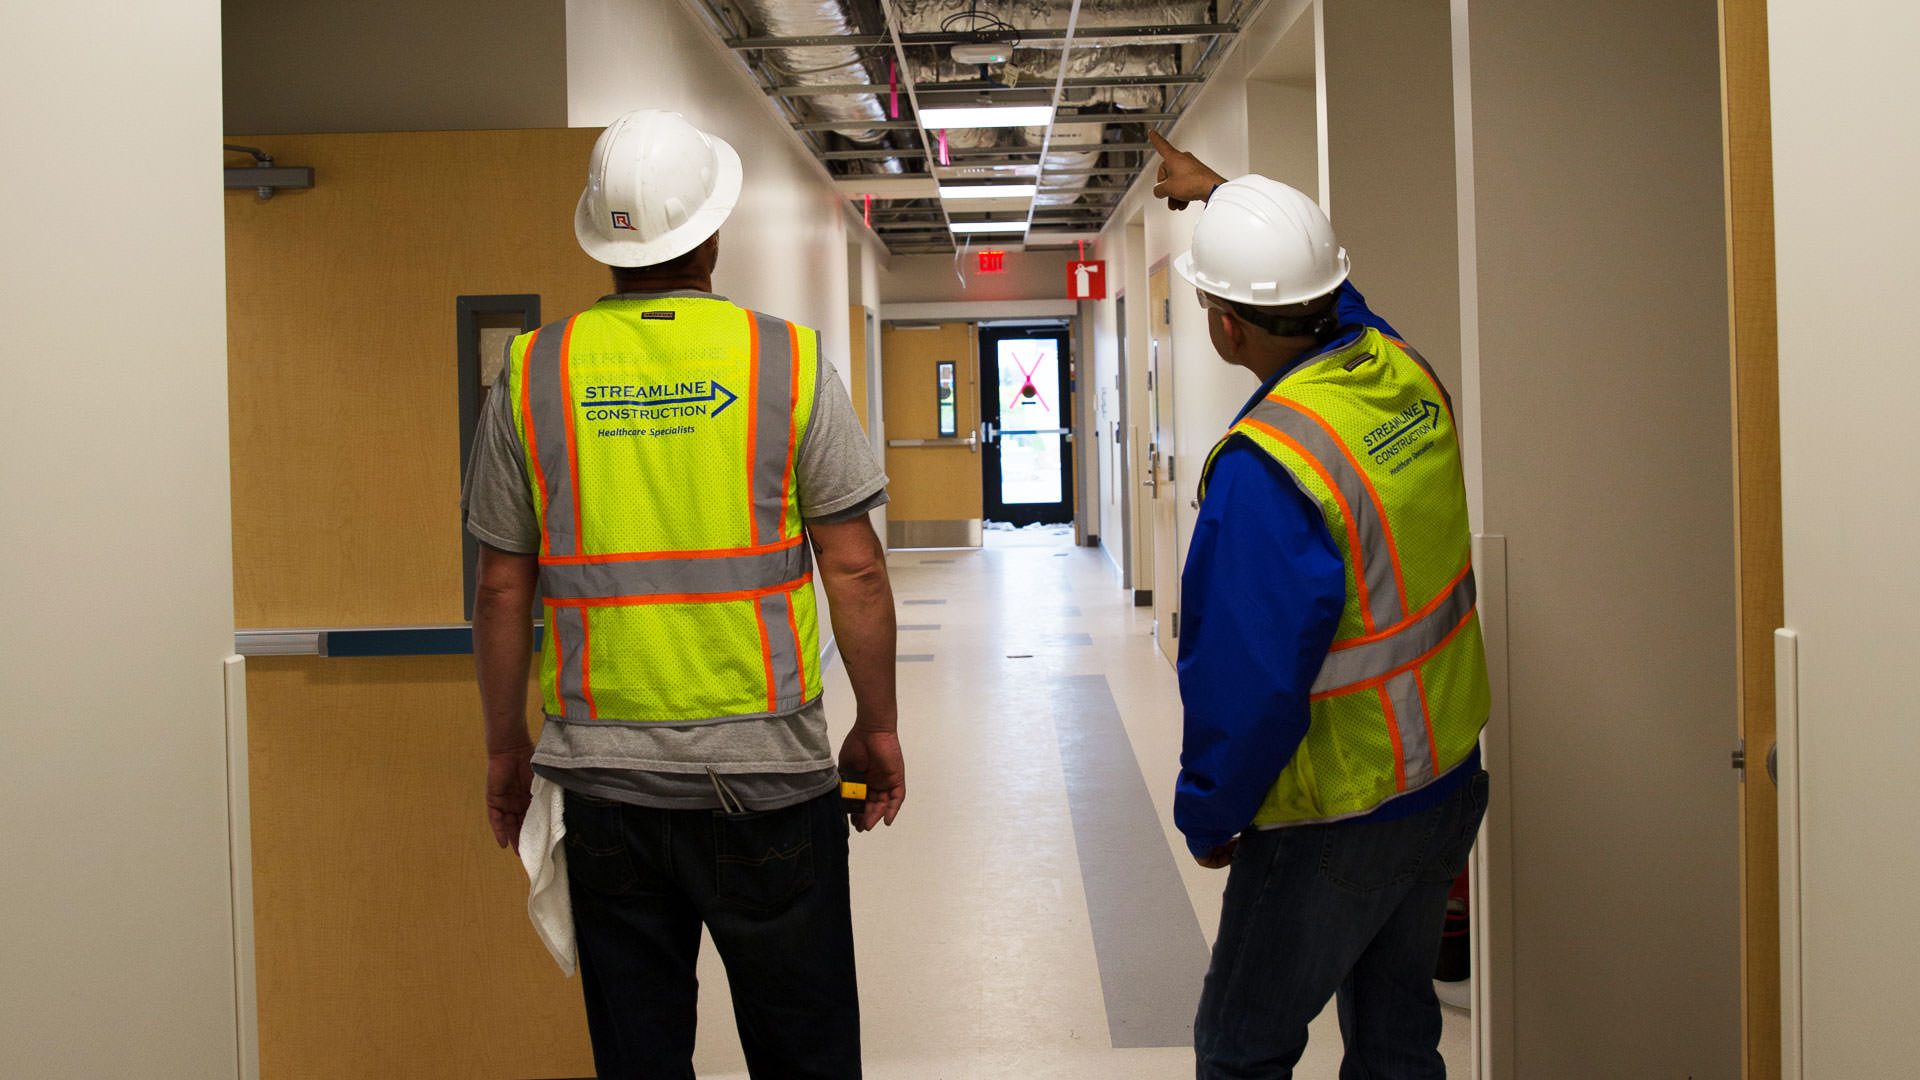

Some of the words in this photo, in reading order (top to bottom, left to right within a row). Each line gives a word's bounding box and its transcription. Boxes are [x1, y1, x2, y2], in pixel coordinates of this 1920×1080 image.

[979, 250, 1004, 271] EXIT
[585, 381, 706, 399] STREAMLINE
[585, 405, 706, 421] CONSTRUCTION
[597, 427, 646, 437] Healthcare
[650, 425, 695, 437] Specialists
[1363, 402, 1423, 447] STREAMLINE
[1375, 423, 1432, 465] CONSTRUCTION
